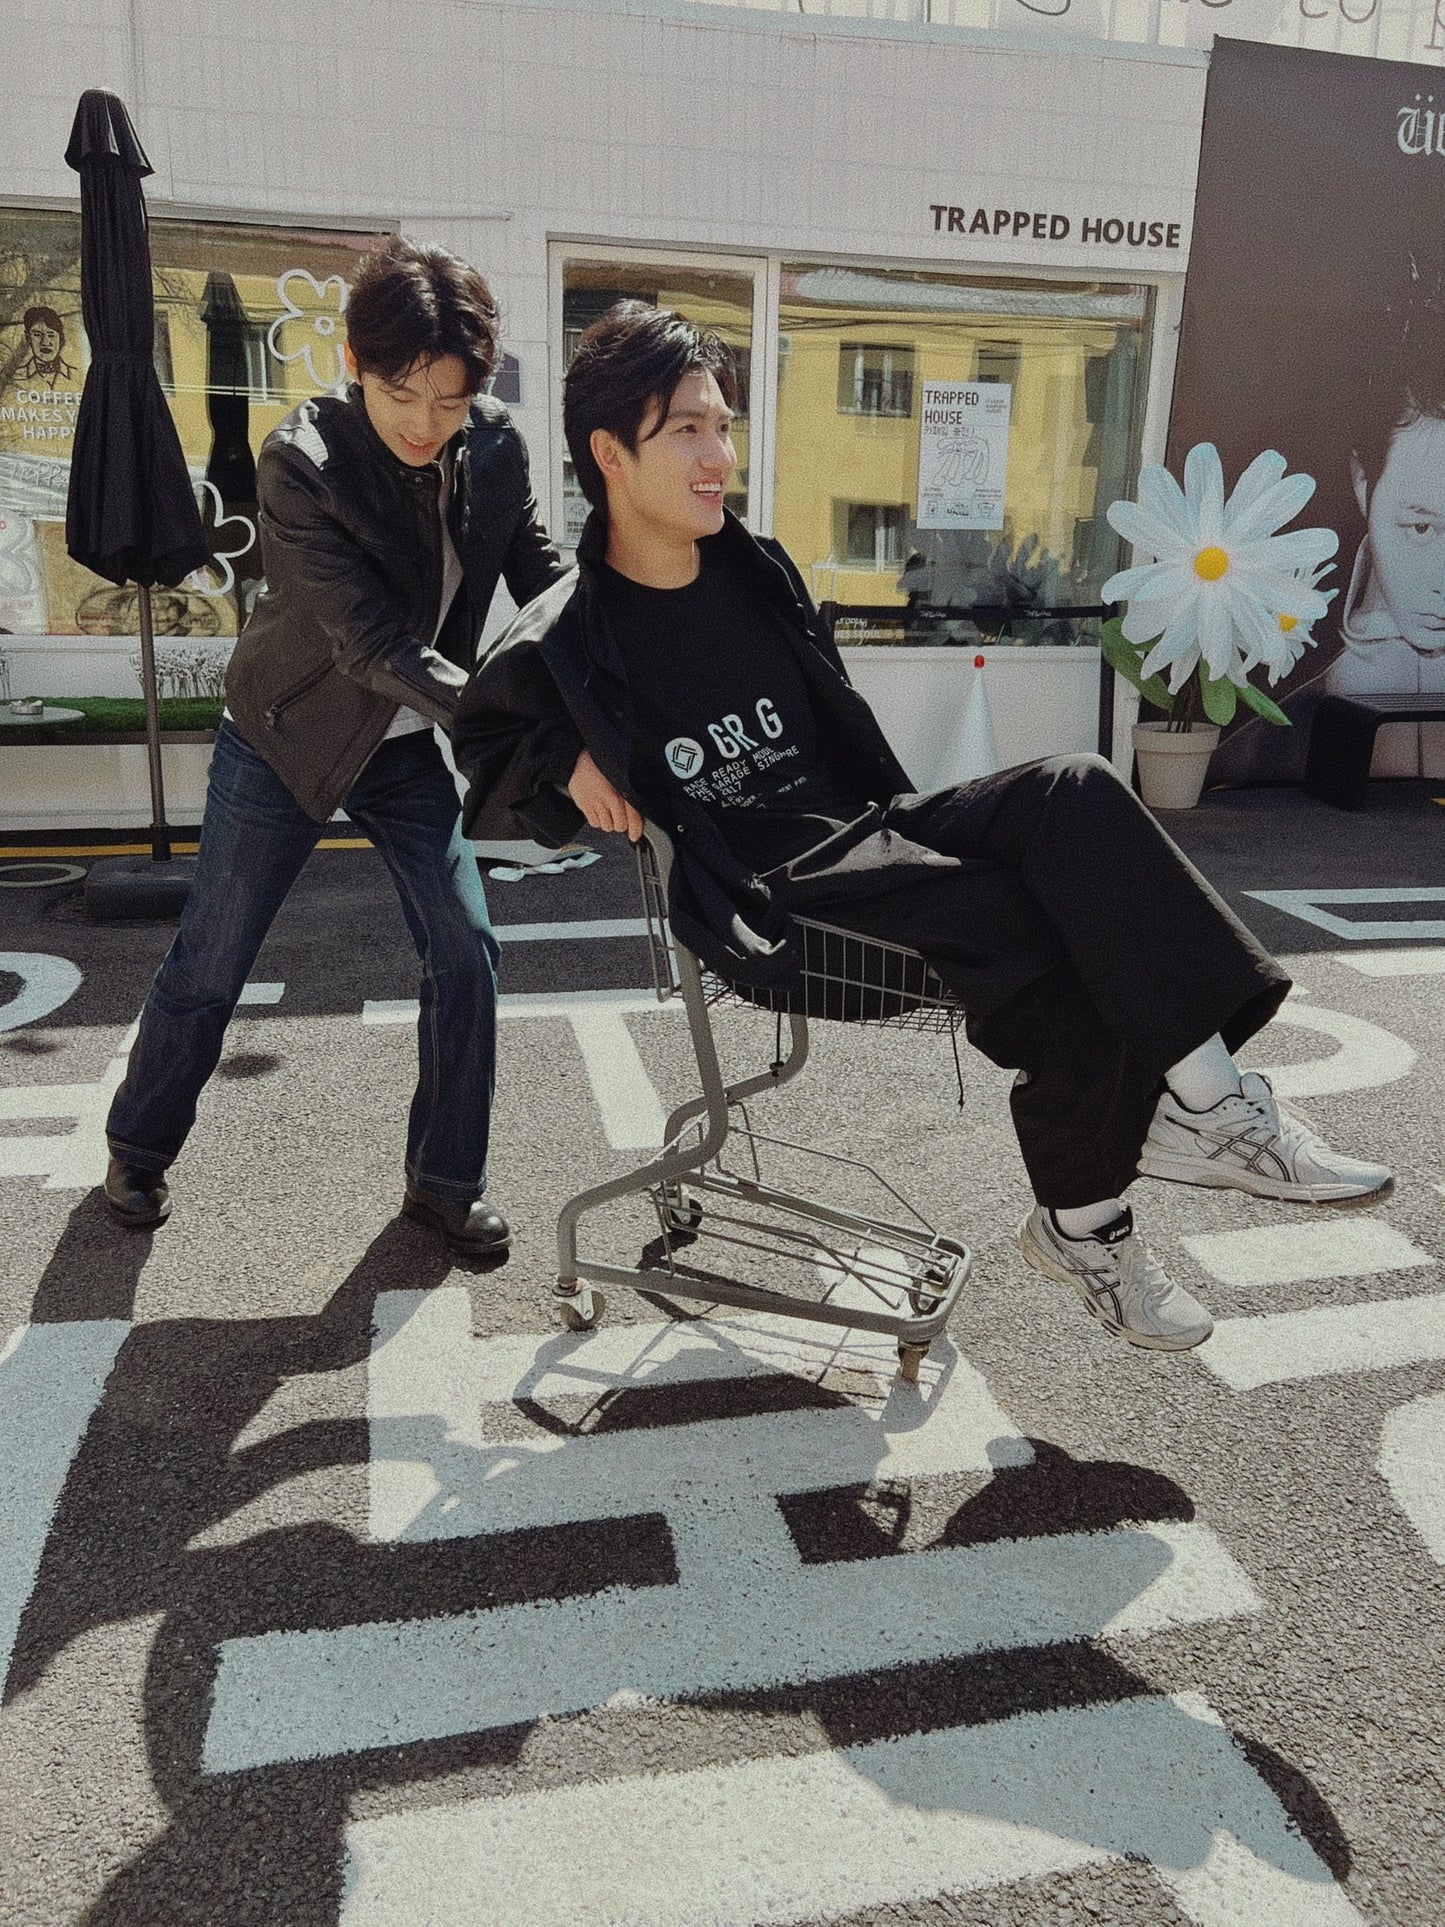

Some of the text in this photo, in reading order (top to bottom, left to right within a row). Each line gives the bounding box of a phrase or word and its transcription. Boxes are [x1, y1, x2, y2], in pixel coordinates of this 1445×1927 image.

[930, 204, 1181, 248] TRAPPED HOUSE
[924, 390, 979, 406] TRAPPED
[1, 406, 63, 423] MAKES
[924, 410, 962, 425] HOUSE
[712, 759, 747, 781] READY
